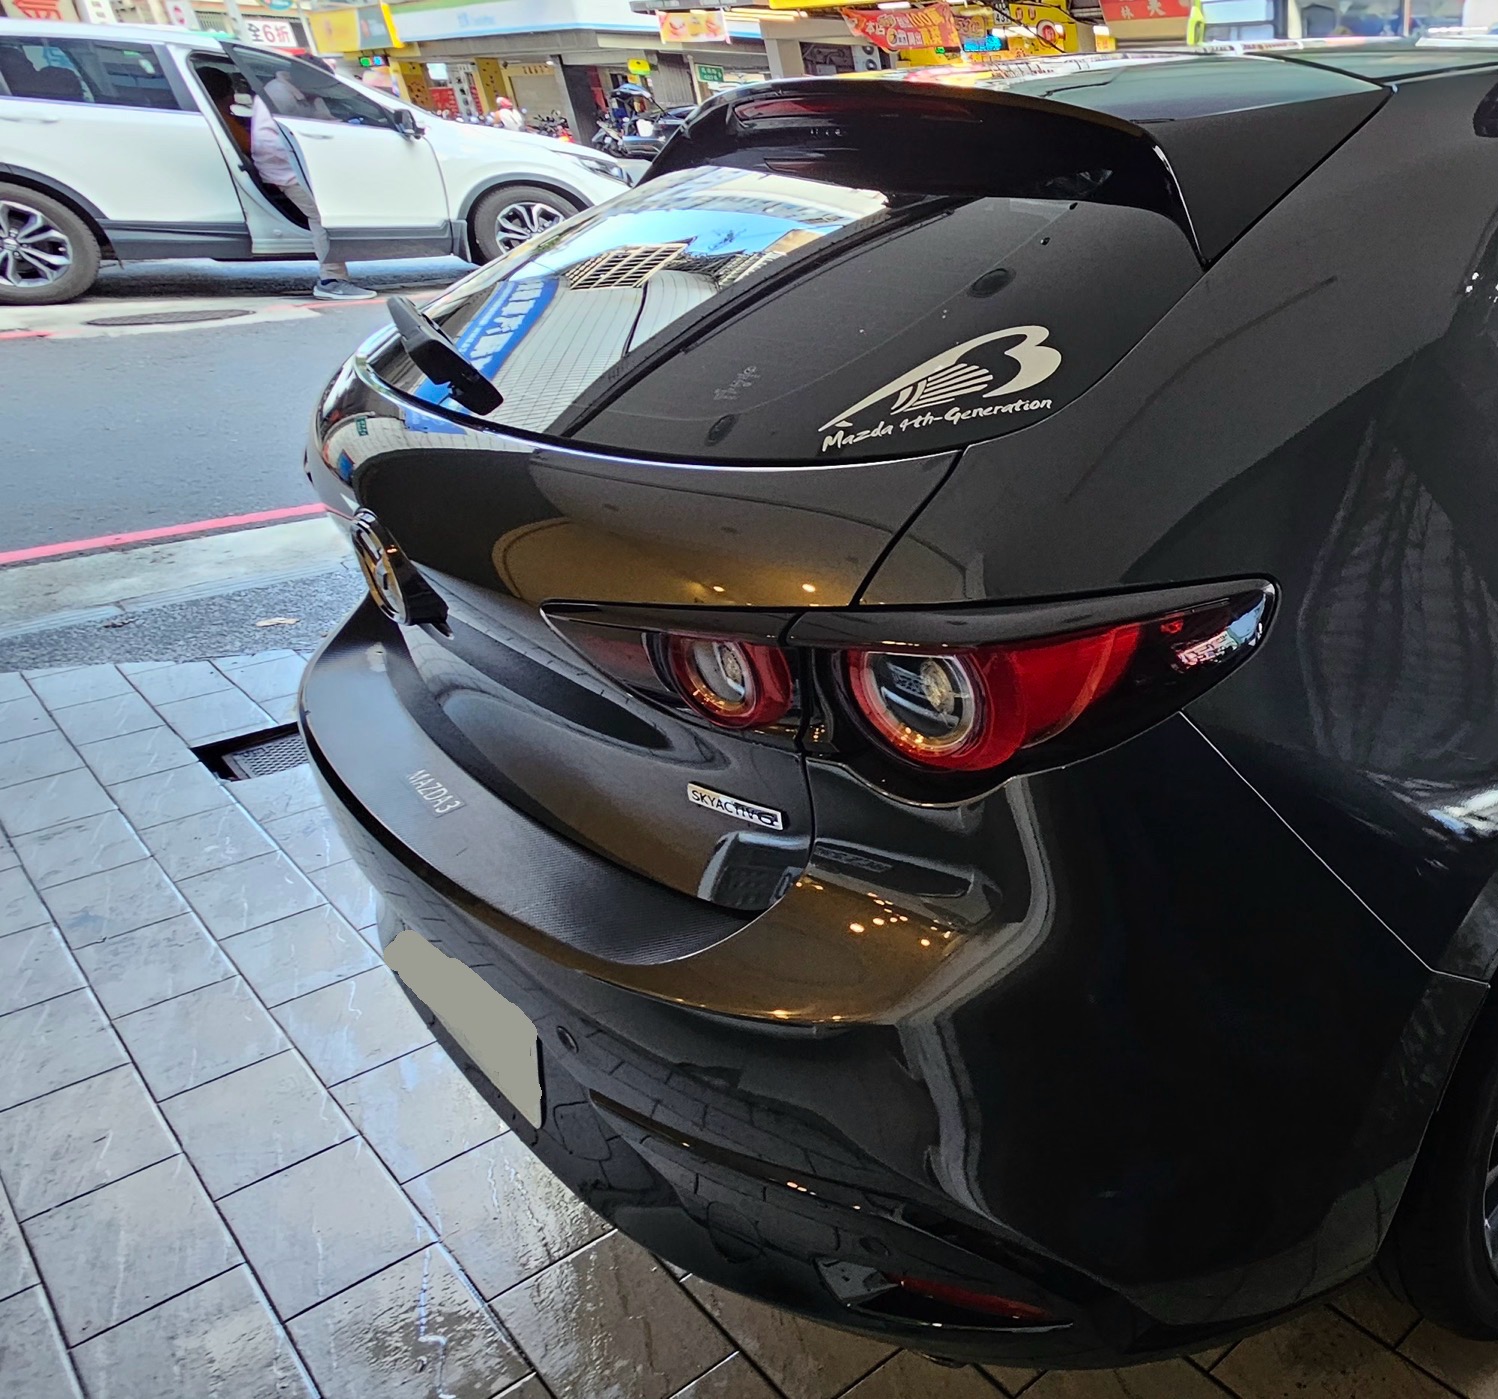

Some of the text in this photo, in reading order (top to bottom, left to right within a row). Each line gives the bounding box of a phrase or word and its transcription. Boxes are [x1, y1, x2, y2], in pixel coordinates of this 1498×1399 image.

[247, 22, 292, 44] 全6折
[821, 396, 1053, 453] Mazda 4th-Generation
[408, 769, 462, 813] MAZDA3
